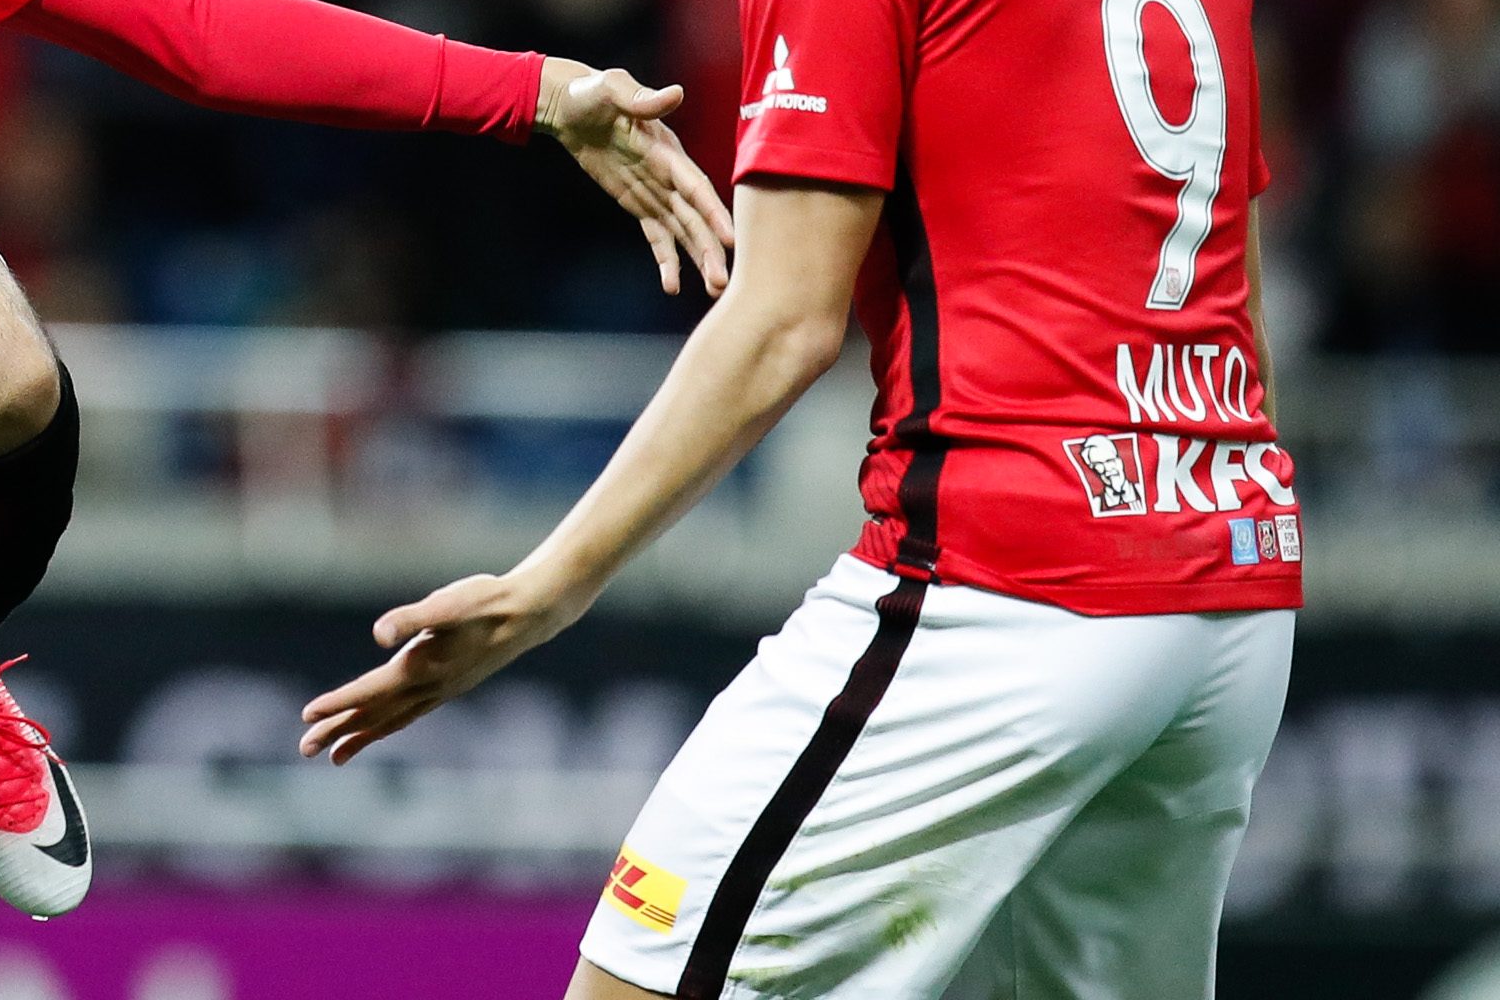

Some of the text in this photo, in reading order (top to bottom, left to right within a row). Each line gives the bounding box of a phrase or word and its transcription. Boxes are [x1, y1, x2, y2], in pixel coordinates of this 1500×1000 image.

[775, 93, 828, 114] MOTORS
[1115, 343, 1252, 424] MUTO
[1152, 432, 1296, 513] KFC
